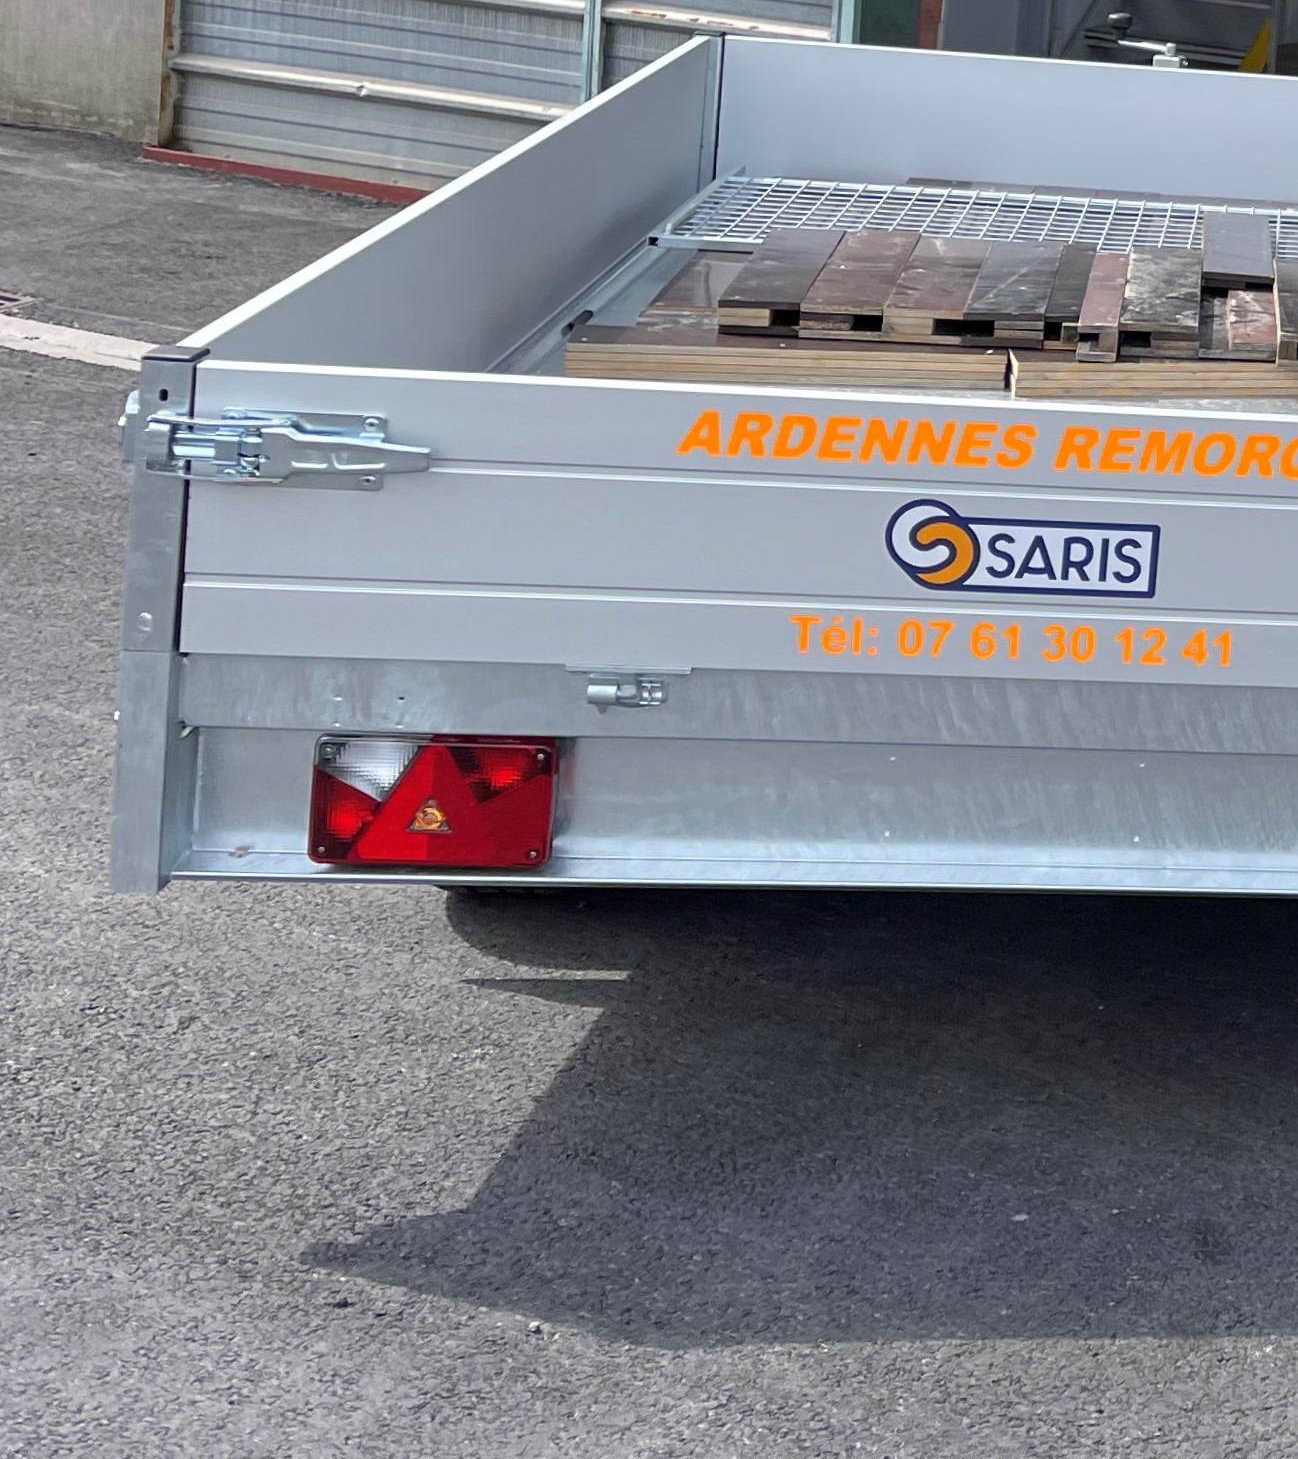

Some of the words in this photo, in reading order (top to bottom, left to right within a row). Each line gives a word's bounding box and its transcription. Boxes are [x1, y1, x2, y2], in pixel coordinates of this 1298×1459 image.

[676, 408, 1039, 470] ARDENNES
[985, 532, 1144, 585] SARIS
[791, 615, 878, 656] Tél:
[897, 619, 952, 658] 07
[970, 621, 1020, 661] 61
[1041, 624, 1097, 664] 30
[1115, 626, 1168, 666] 12
[1181, 629, 1233, 668] 41
